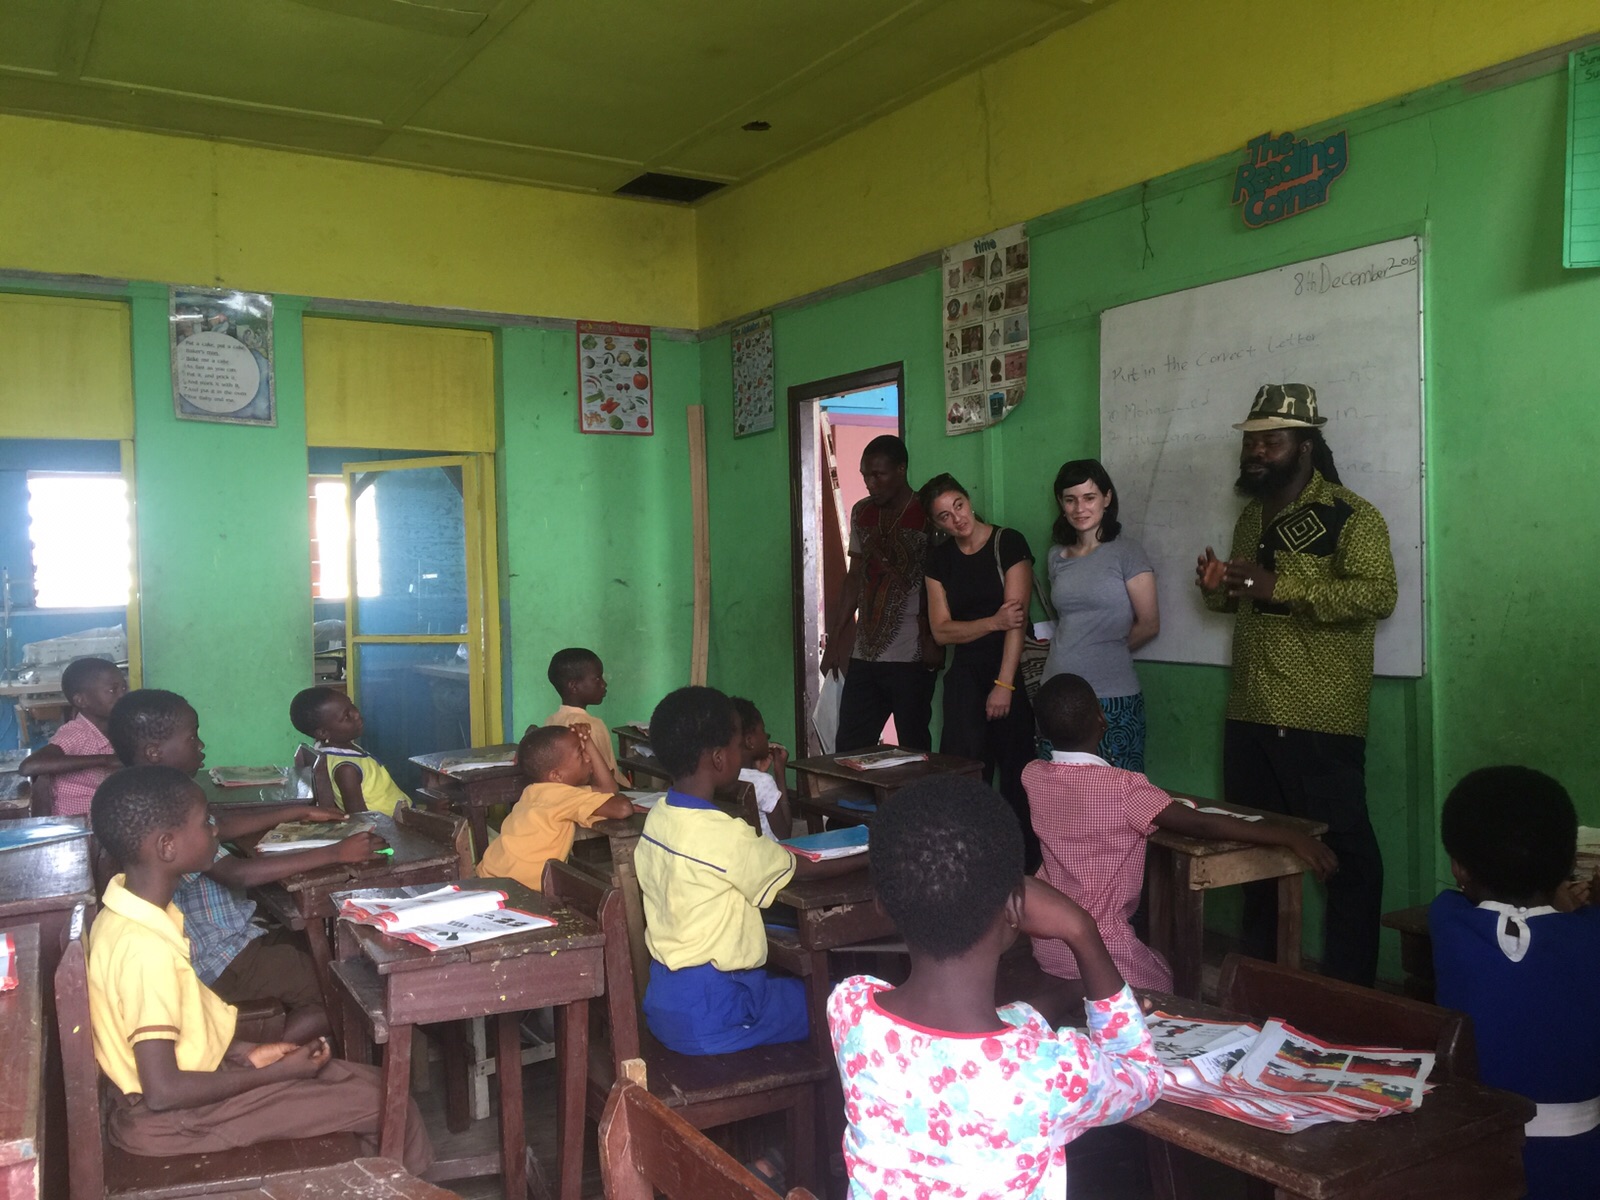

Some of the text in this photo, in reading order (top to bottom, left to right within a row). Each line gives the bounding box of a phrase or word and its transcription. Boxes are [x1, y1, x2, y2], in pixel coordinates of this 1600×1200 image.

[1232, 130, 1348, 203] Reading
[1247, 131, 1295, 165] The
[1244, 180, 1328, 226] Corner
[973, 238, 997, 254] time
[1318, 262, 1389, 294] December
[1387, 254, 1418, 270] 2015
[1111, 366, 1140, 385] Put
[1141, 363, 1156, 378] in
[1164, 354, 1189, 373] the
[1196, 345, 1257, 367] Correct
